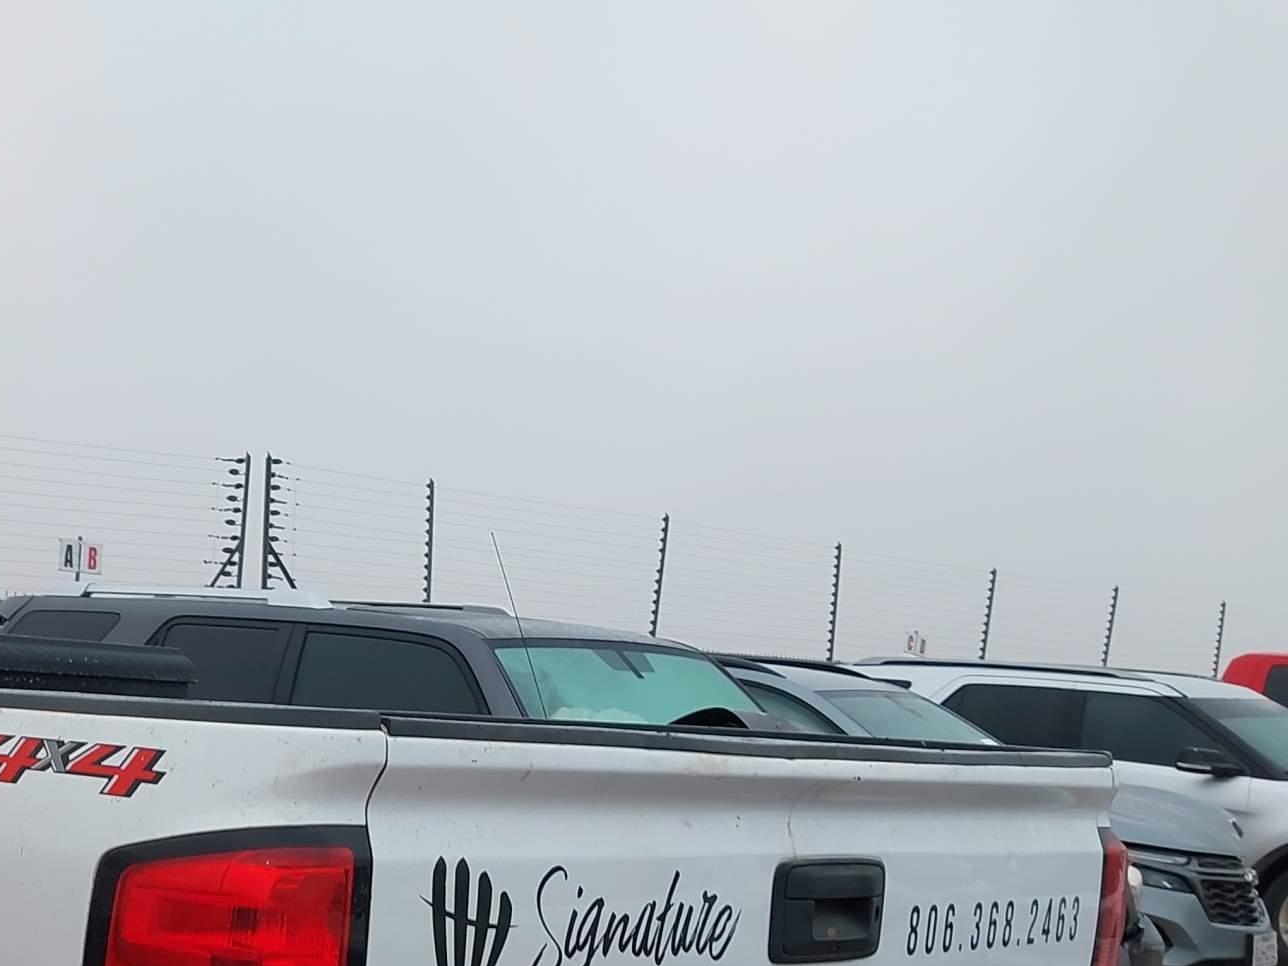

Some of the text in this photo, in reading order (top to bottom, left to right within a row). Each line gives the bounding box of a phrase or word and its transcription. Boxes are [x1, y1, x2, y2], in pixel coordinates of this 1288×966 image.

[64, 544, 97, 570] A B
[906, 895, 1081, 956] 806.368.2463
